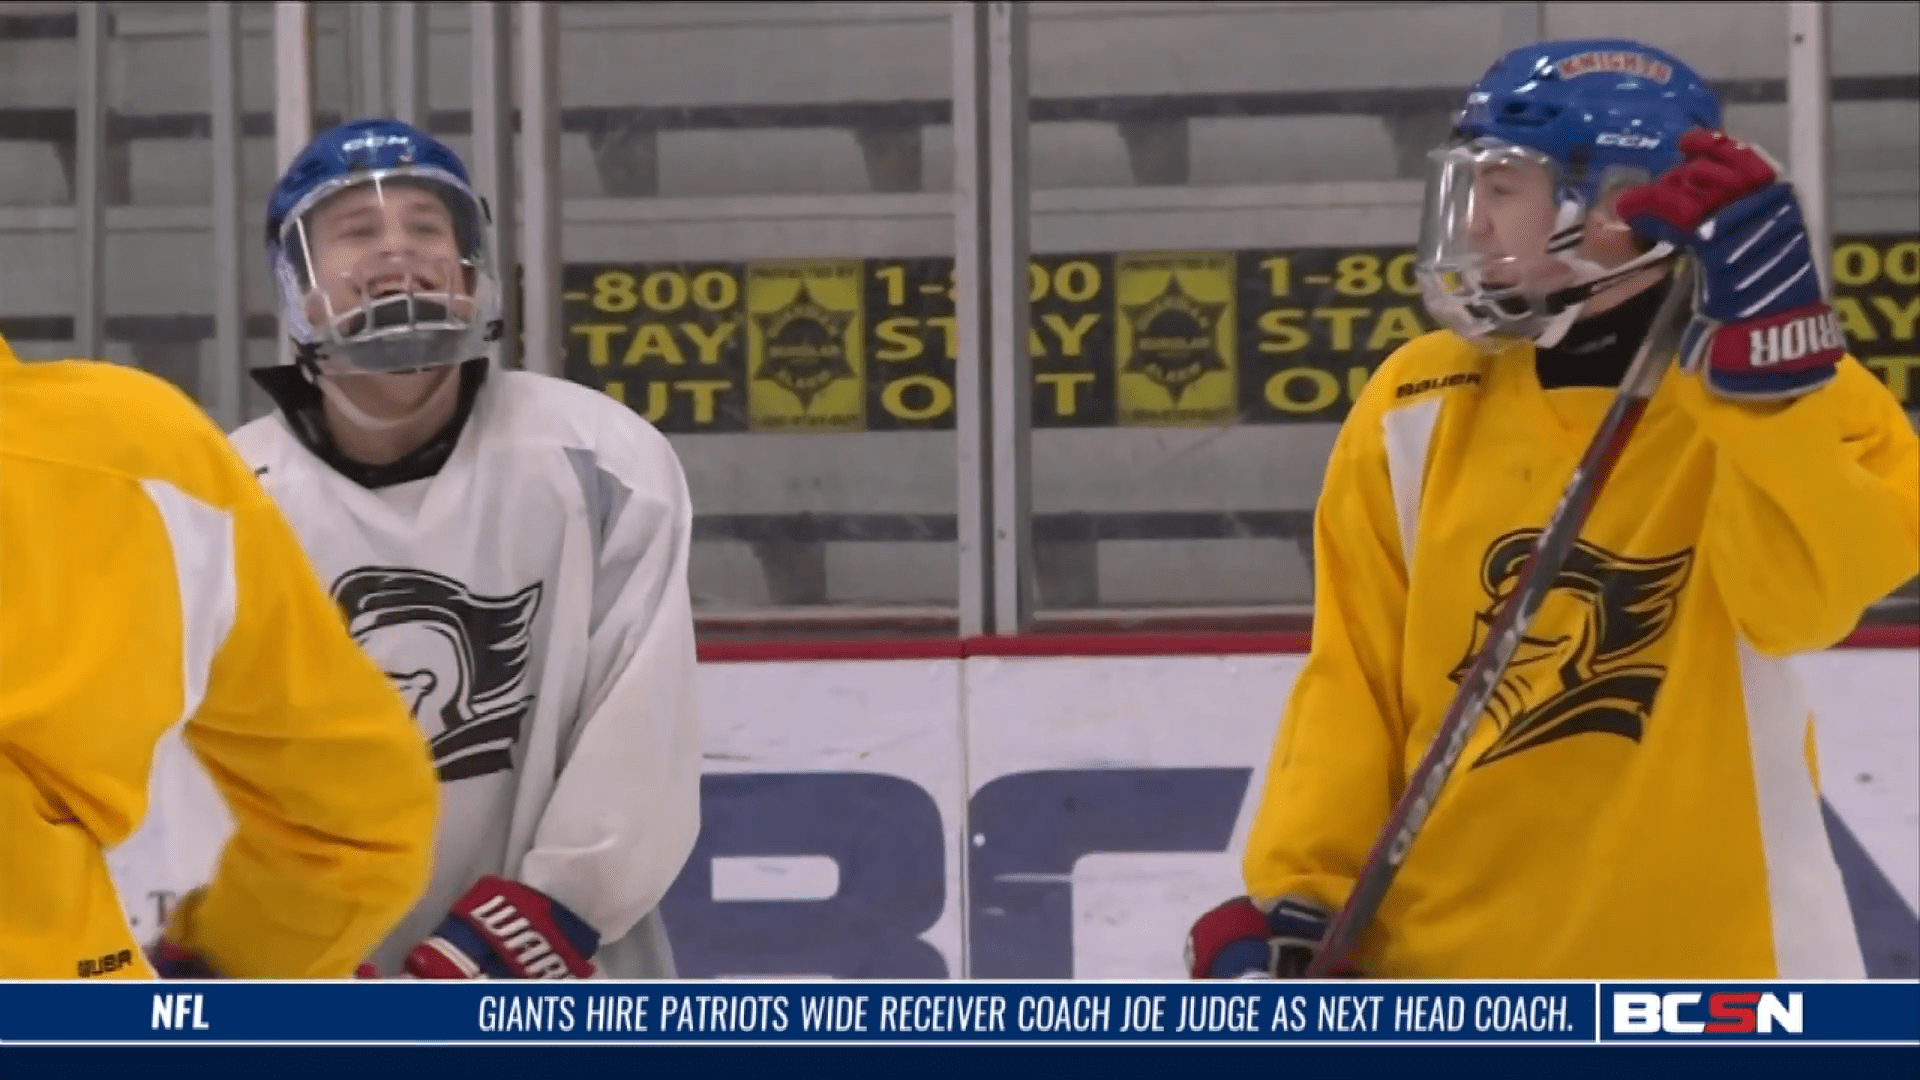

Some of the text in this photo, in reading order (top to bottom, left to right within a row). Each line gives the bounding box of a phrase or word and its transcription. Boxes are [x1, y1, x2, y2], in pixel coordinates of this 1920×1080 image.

[565, 270, 738, 312] -800
[571, 322, 737, 366] TAY
[1259, 306, 1428, 353] STA
[604, 379, 732, 424] UT
[470, 895, 575, 979] WAR
